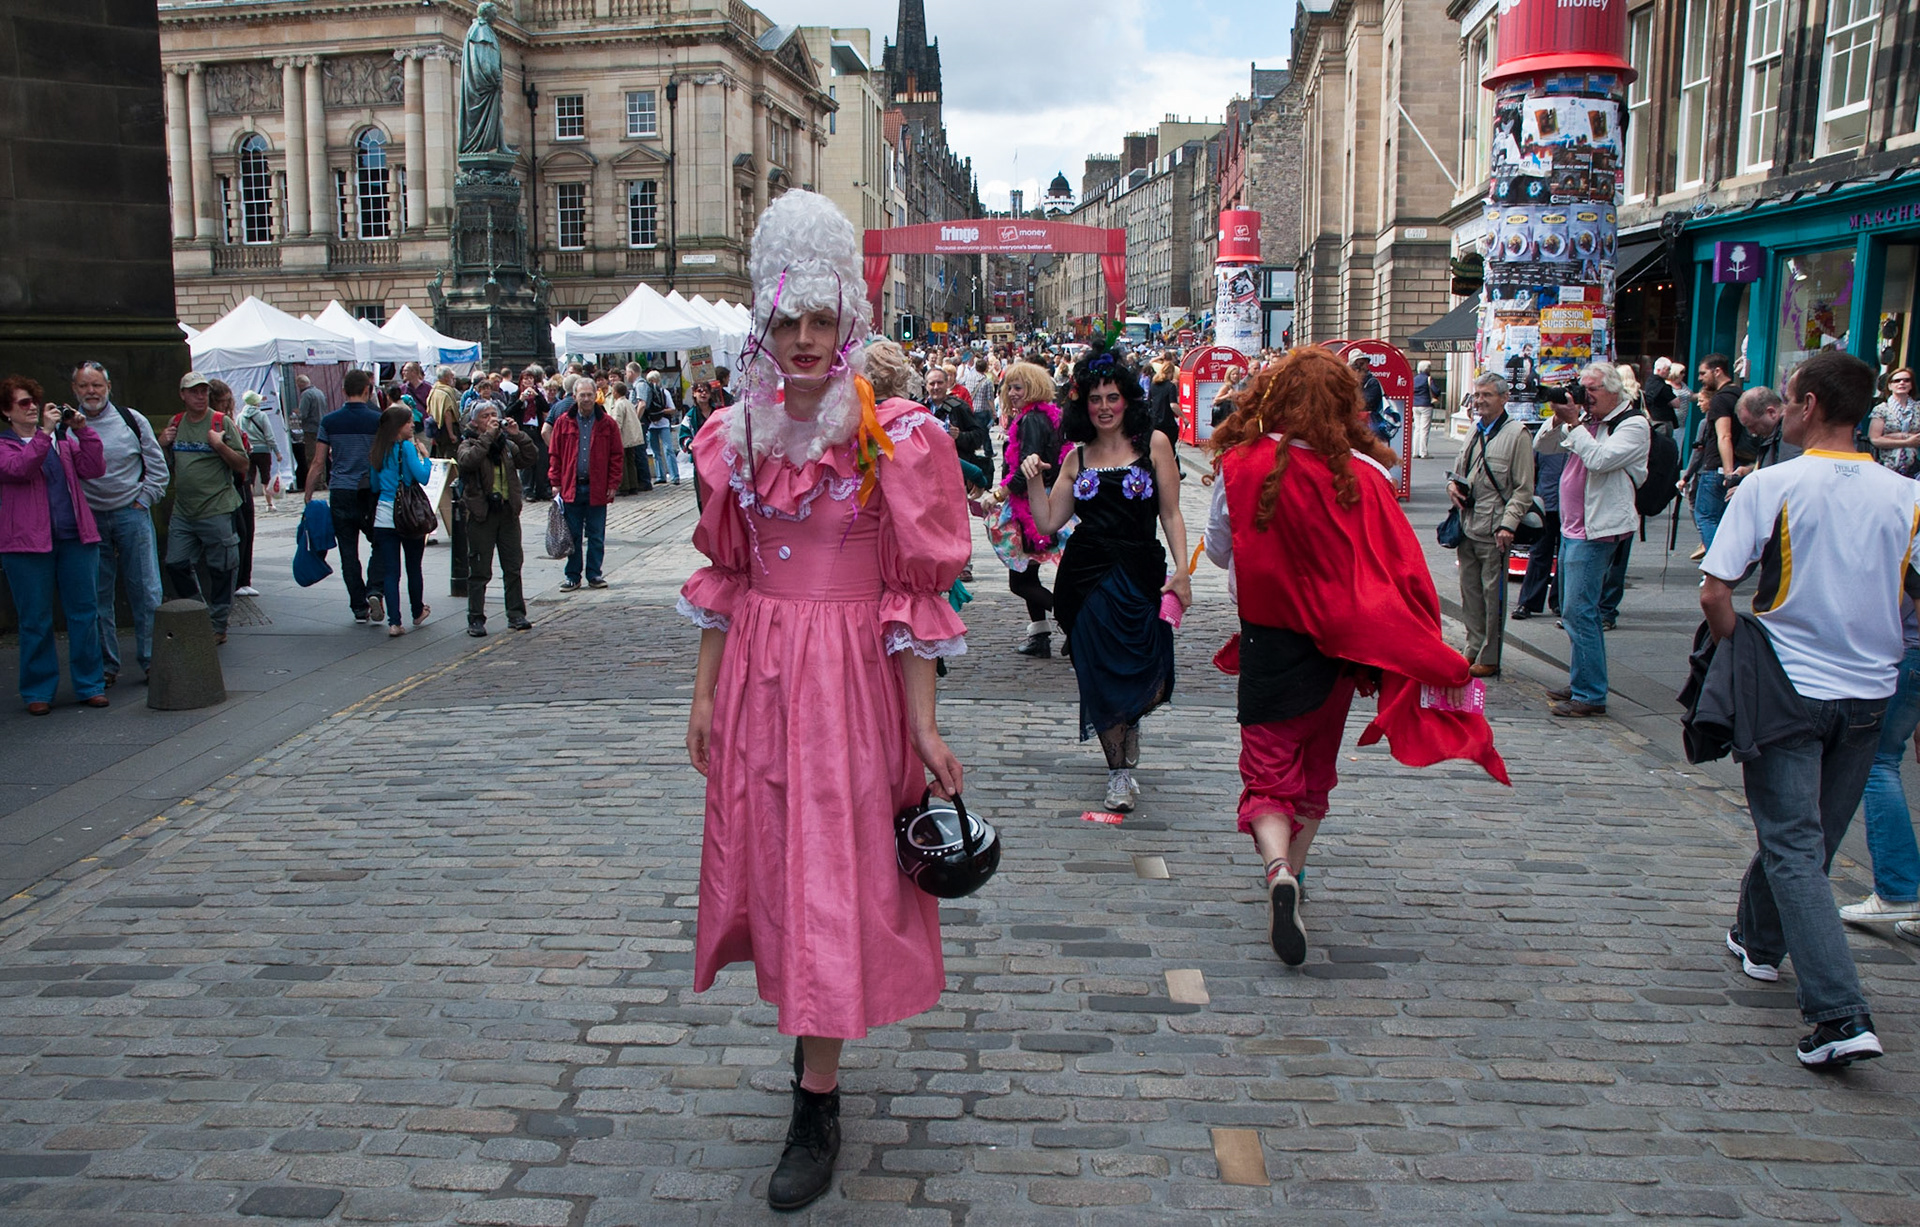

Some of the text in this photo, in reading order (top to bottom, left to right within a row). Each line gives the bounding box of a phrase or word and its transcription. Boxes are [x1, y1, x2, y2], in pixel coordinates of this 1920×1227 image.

[1557, 0, 1609, 11] money
[940, 226, 979, 243] fringe
[1019, 229, 1047, 237] money
[1552, 310, 1584, 319] MISSION
[1542, 320, 1592, 329] SUGGESTIBLE
[1423, 341, 1453, 352] SPECIALIST
[1834, 464, 1860, 474] EVERLAST
